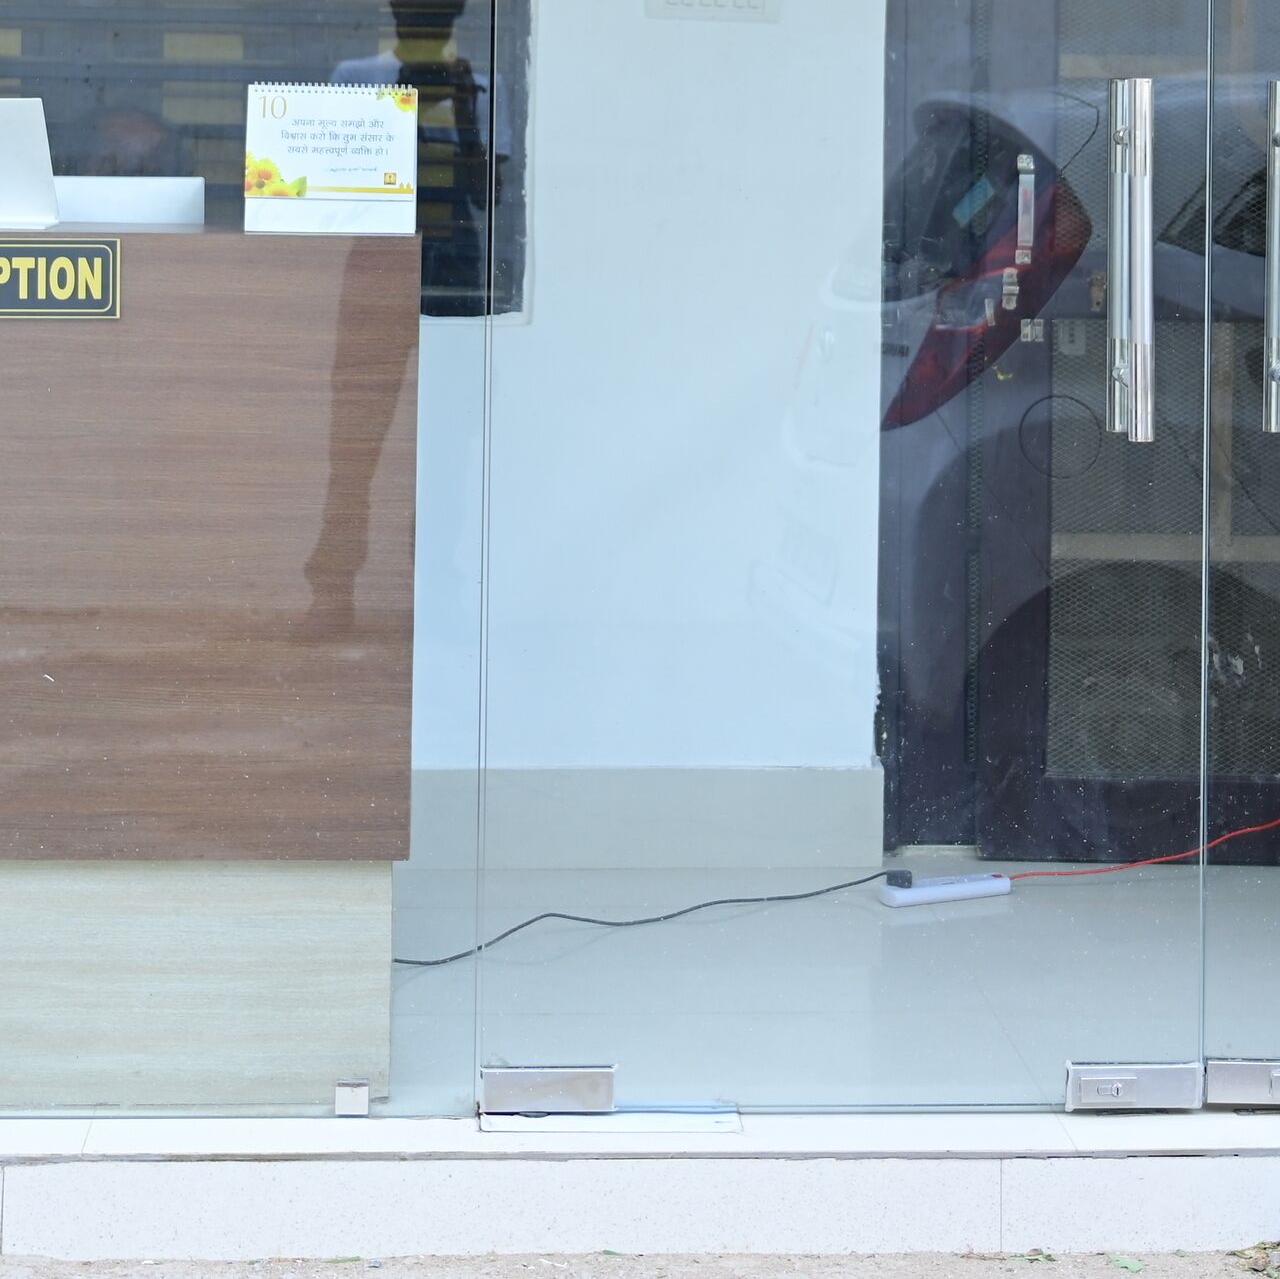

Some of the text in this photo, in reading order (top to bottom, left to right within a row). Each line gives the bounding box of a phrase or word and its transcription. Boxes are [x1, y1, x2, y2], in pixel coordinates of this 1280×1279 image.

[259, 95, 287, 119] 10
[369, 118, 384, 128] और
[329, 131, 340, 140] कि
[343, 133, 357, 144] तुम
[385, 132, 394, 142] के
